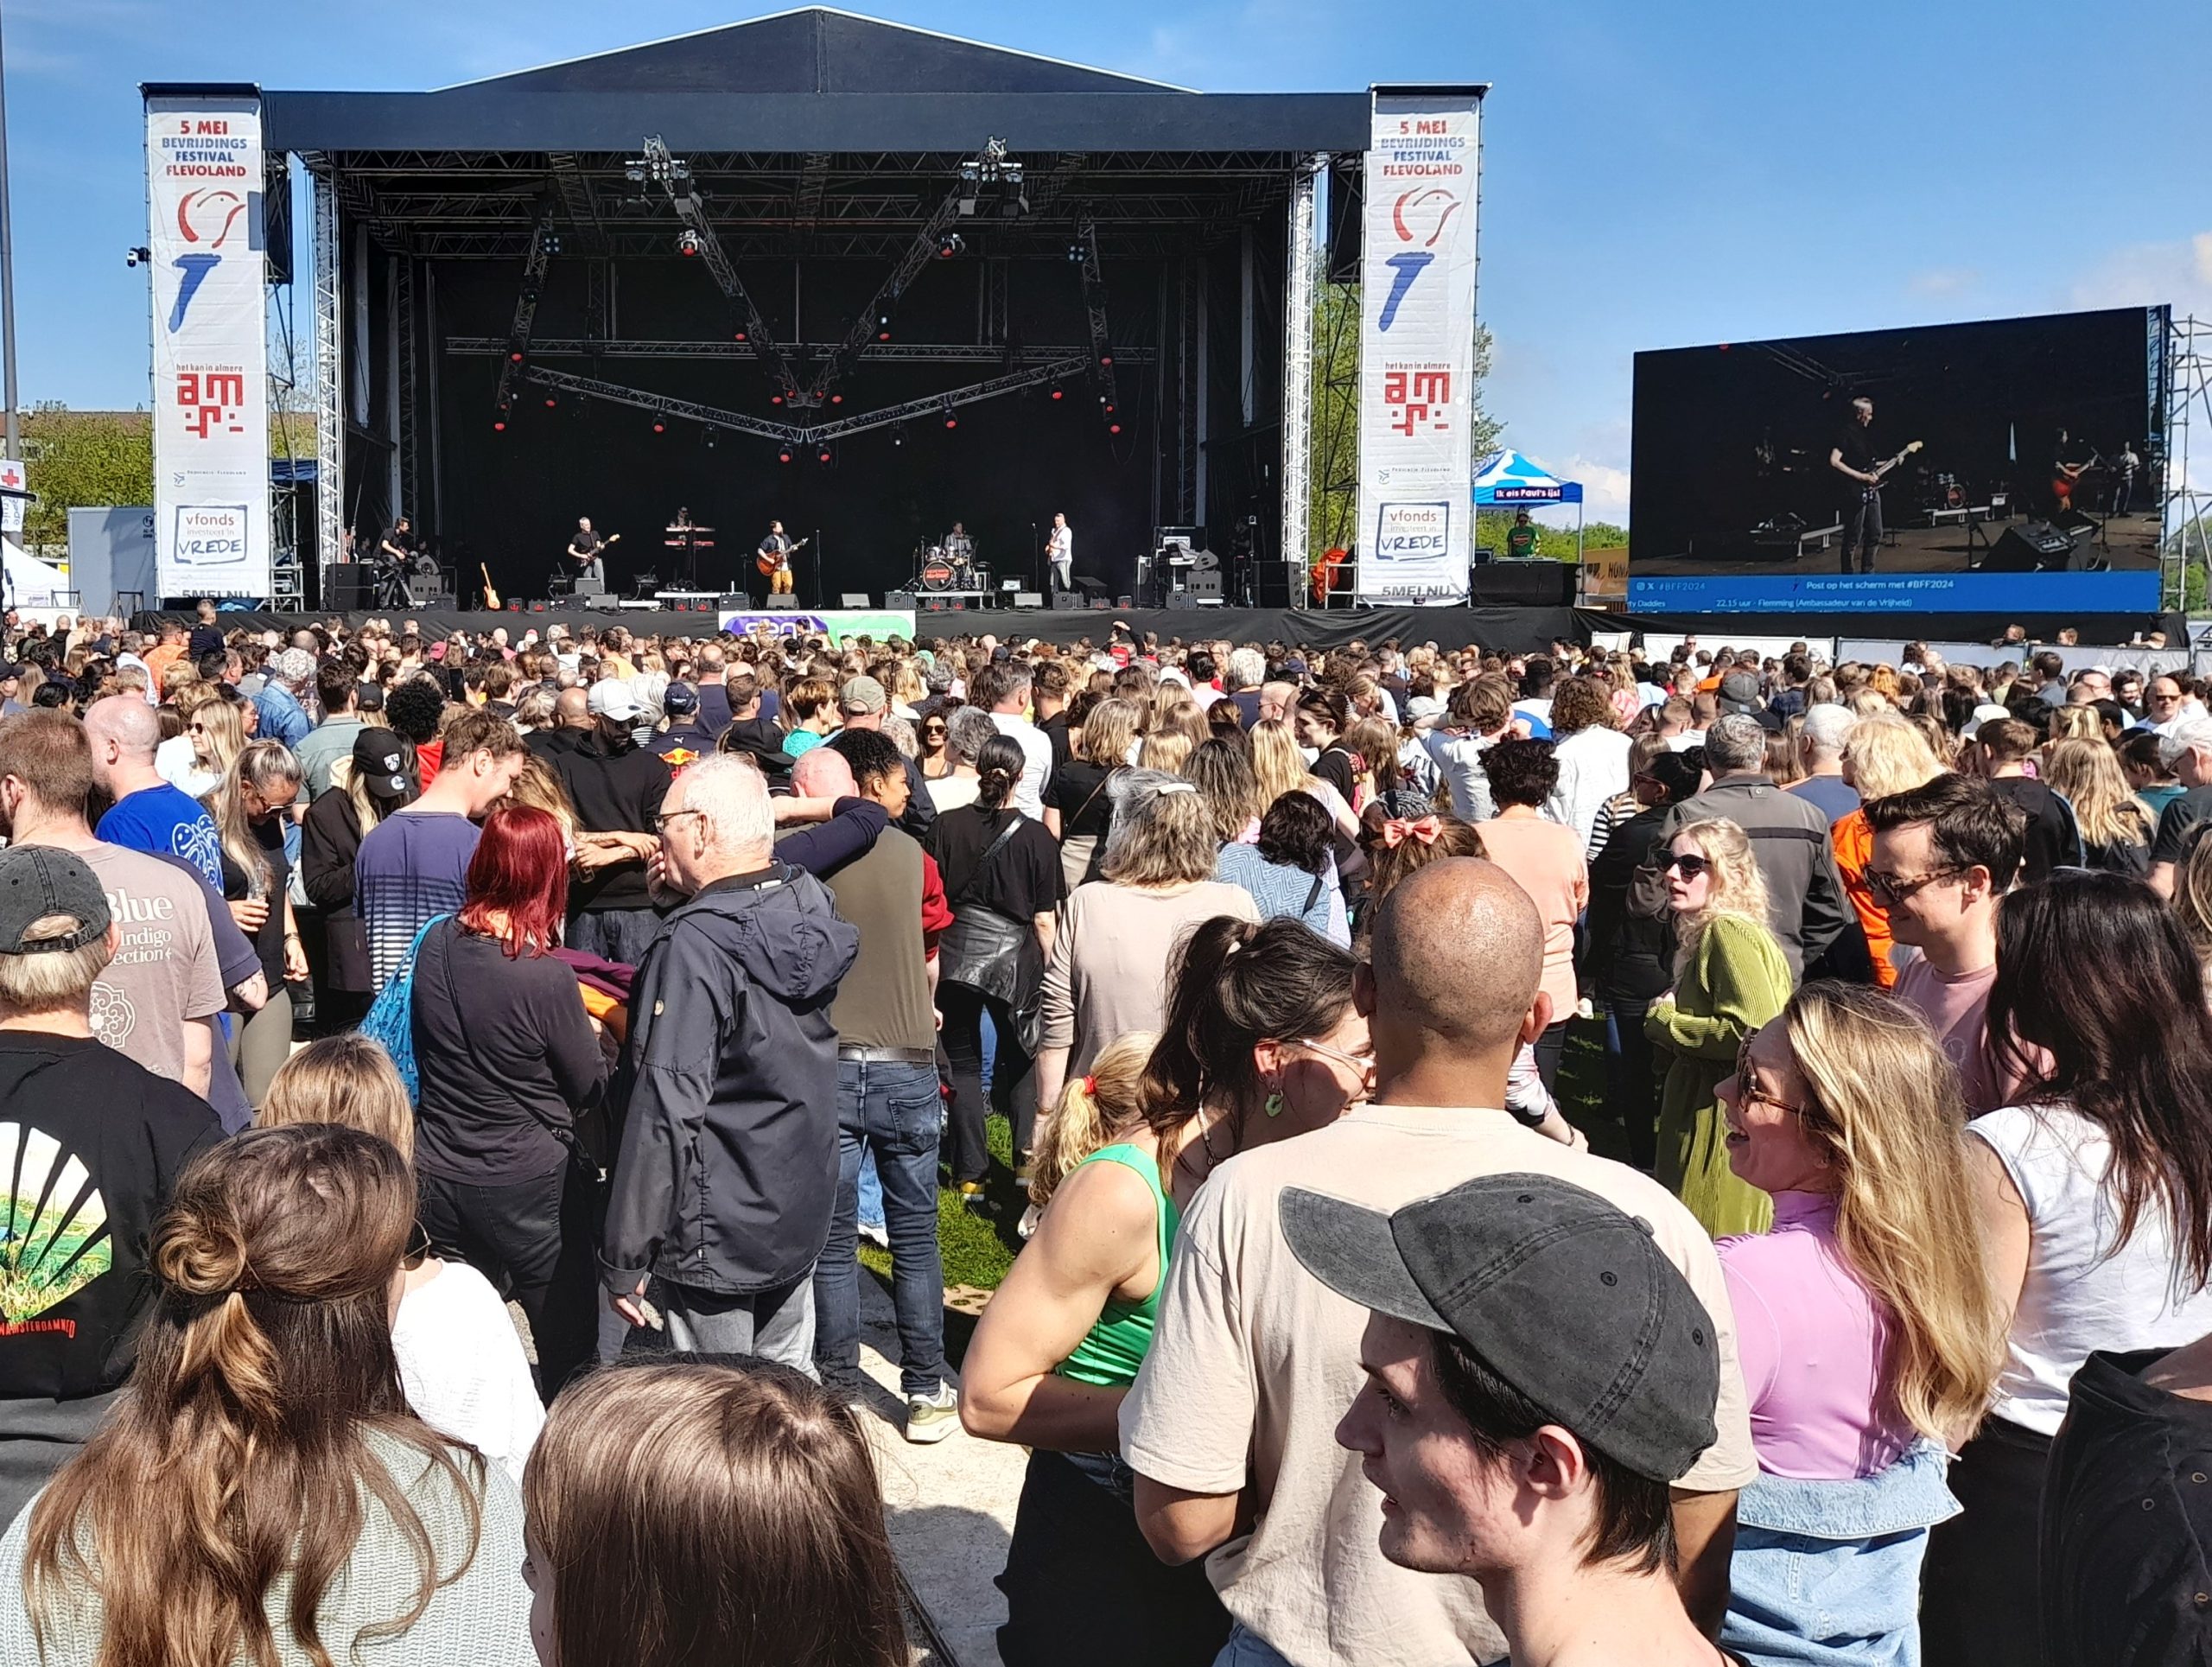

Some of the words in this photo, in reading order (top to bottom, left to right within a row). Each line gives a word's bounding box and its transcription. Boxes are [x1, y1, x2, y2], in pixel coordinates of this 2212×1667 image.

[180, 120, 190, 135] 5
[197, 120, 228, 135] MEI
[1400, 121, 1409, 135] 5
[1417, 120, 1447, 135] MEI
[162, 137, 247, 150] BEVRIJDINGS
[1381, 137, 1465, 149] BEVRIJDINGS
[175, 151, 234, 162] FESTIVAL
[1394, 150, 1452, 162] FESTIVAL
[166, 165, 246, 177] FLEVOLAND
[1383, 164, 1463, 176] FLEVOLAND
[176, 363, 188, 372] het
[190, 363, 205, 372] kan
[206, 363, 213, 372] in
[215, 363, 243, 372] almere
[1385, 361, 1398, 370] het
[1400, 361, 1414, 370] kan
[1414, 361, 1422, 370] in
[1423, 361, 1451, 370] almere
[185, 512, 235, 526] vfonds
[1390, 509, 1437, 522] vfonds
[179, 539, 243, 556] VREDE
[1381, 535, 1445, 550] VREDE
[1806, 581, 1825, 589] Post
[1840, 581, 1853, 589] het
[1855, 580, 1886, 589] scherm
[1907, 580, 1955, 589] #BFF2024
[1758, 599, 1795, 608] Flemming
[1796, 598, 1850, 608] (Ambassadeur
[105, 888, 174, 924] Blue
[119, 927, 172, 947] Indigo
[109, 946, 164, 966] ection
